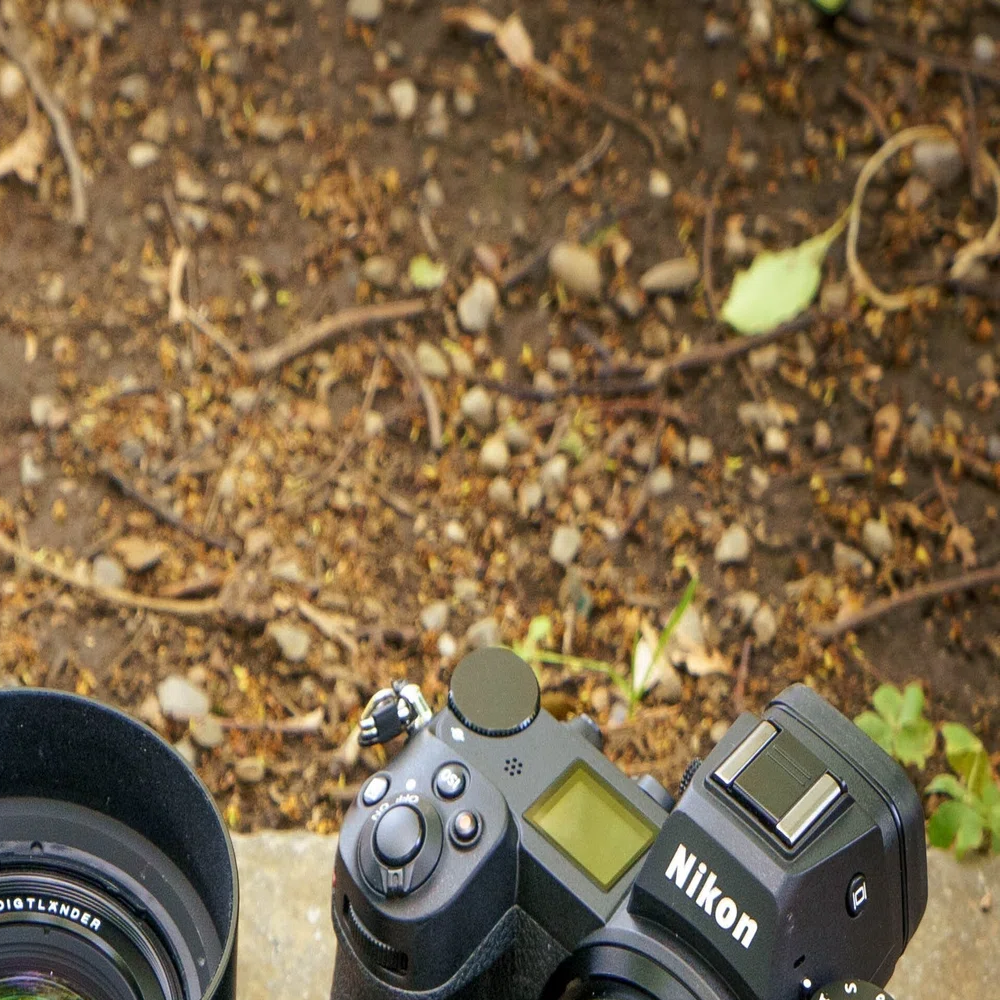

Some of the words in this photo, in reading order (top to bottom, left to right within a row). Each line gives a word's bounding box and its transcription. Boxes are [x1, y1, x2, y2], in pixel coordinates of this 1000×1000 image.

[439, 768, 461, 789] ISO
[665, 843, 758, 949] Nikon
[844, 982, 857, 994] S
